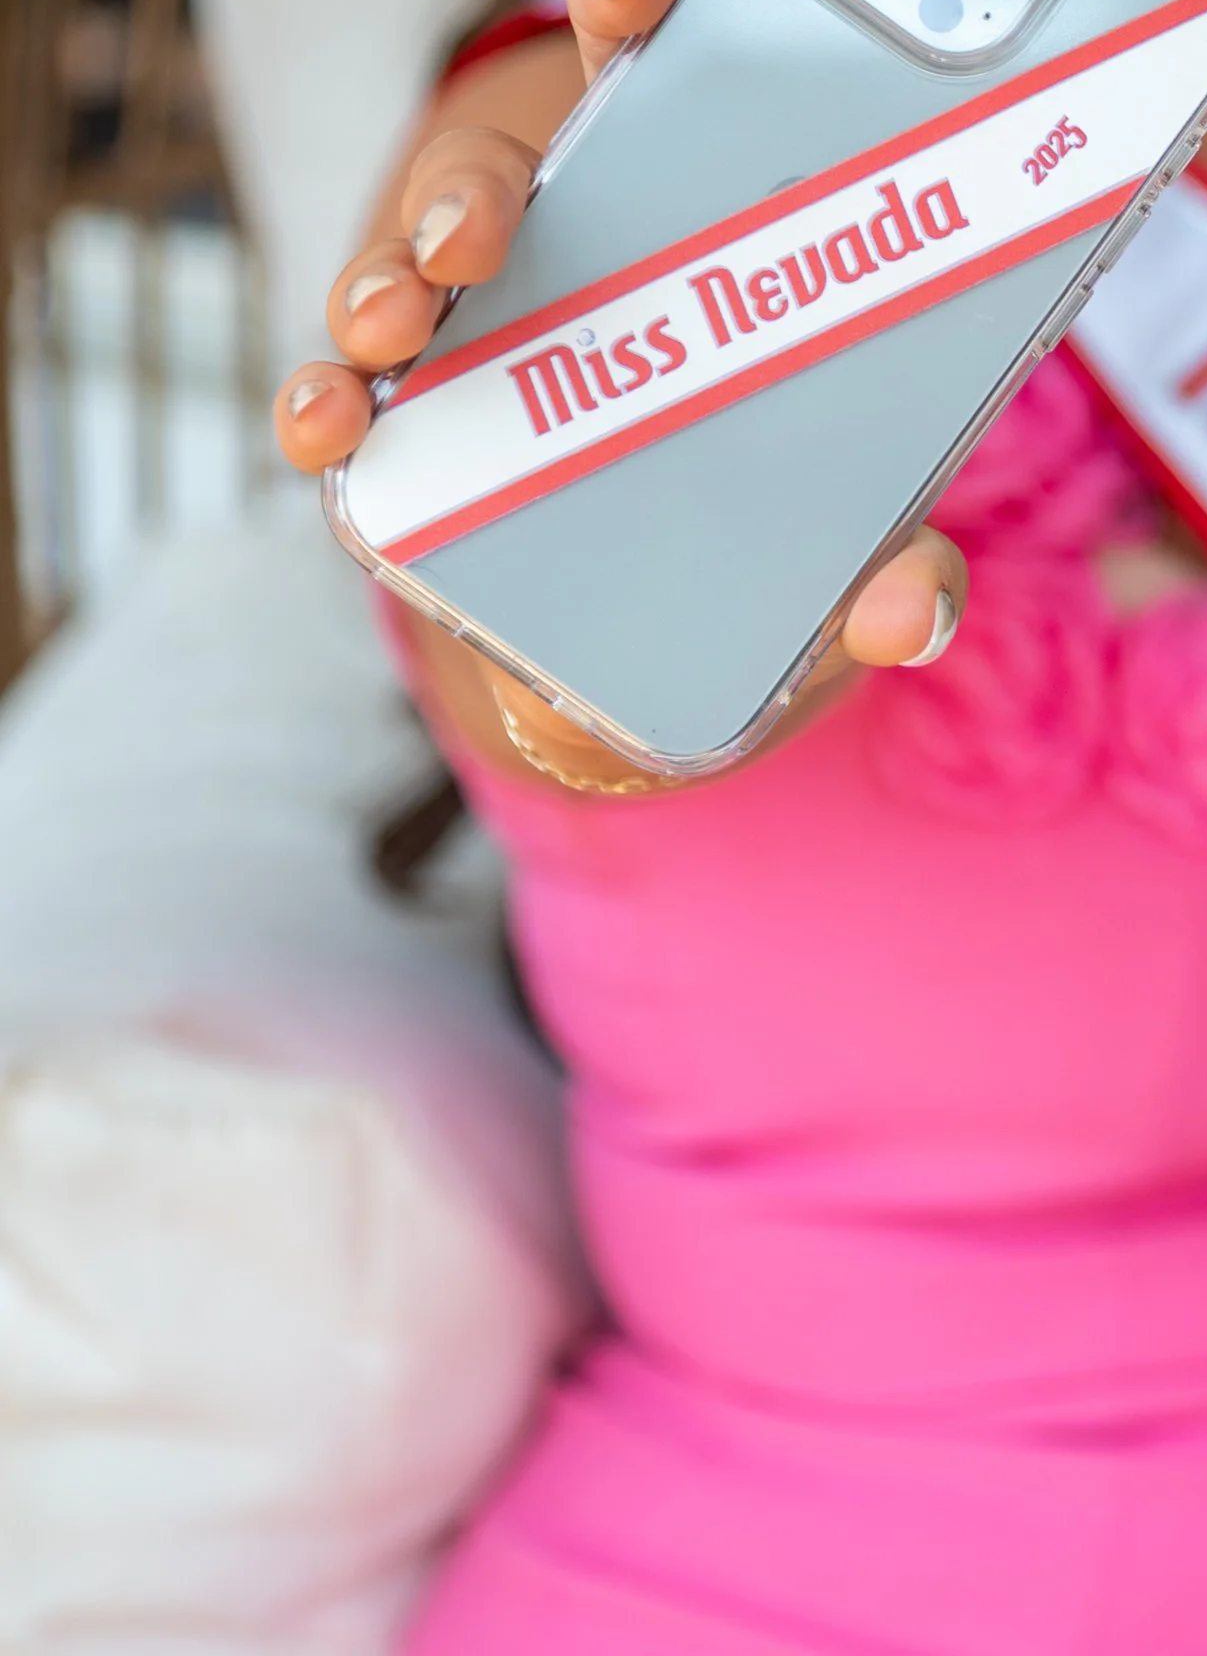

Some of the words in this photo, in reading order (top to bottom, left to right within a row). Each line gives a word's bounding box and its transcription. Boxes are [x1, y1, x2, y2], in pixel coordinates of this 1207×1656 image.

[1021, 116, 1089, 186] 2025
[506, 313, 687, 437] Miss
[687, 178, 969, 348] Nevada
